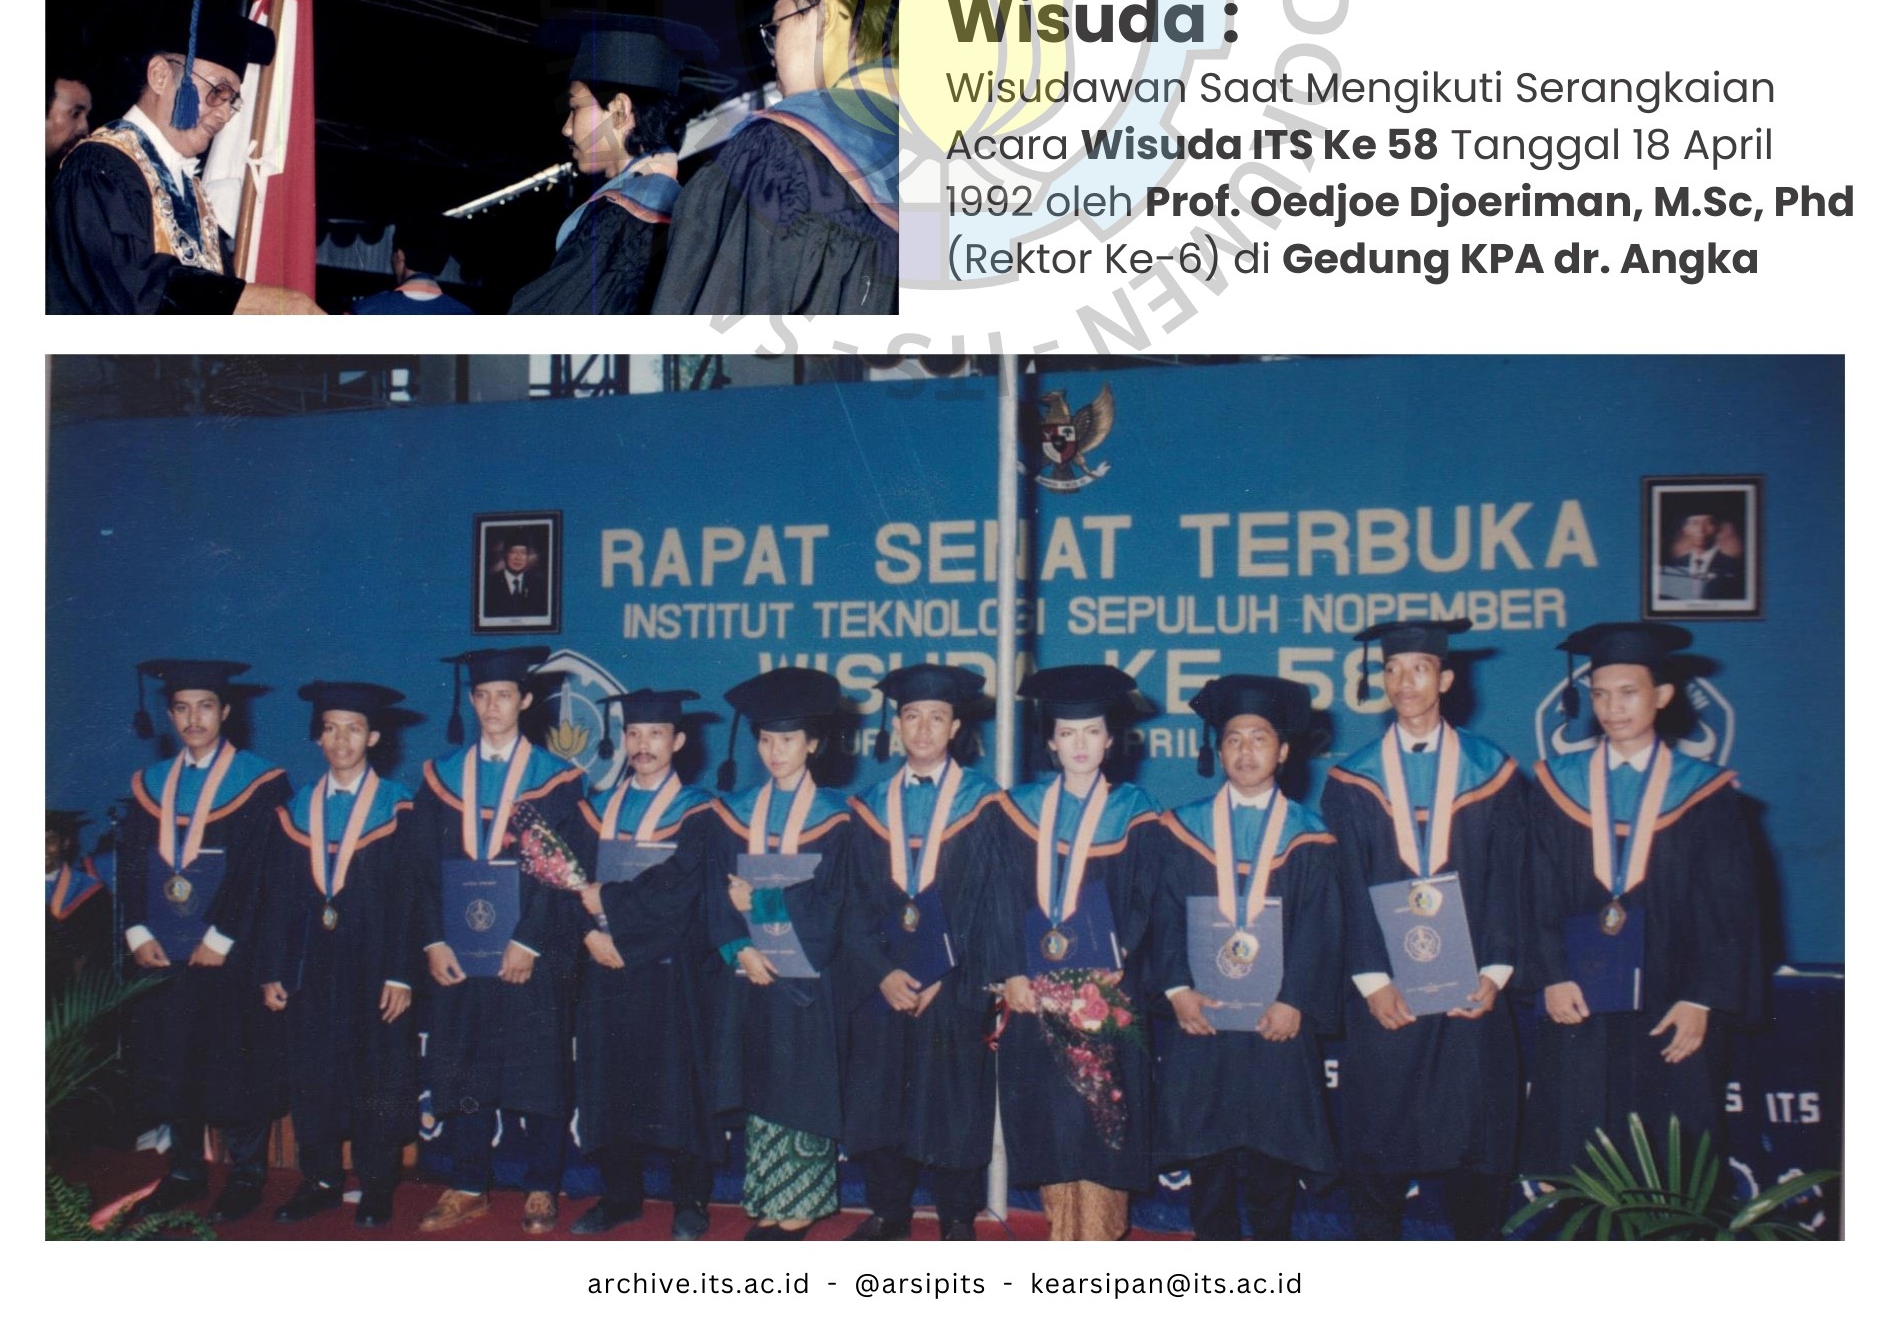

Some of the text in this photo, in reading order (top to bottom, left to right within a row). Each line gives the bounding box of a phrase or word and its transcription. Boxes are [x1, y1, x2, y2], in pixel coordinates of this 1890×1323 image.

[601, 499, 1599, 588] RAPAT SENAT TERBUKA
[622, 602, 794, 640] INSTITUT
[1067, 594, 1279, 635] SEPULUH
[1302, 586, 1567, 634] NOPEMBER
